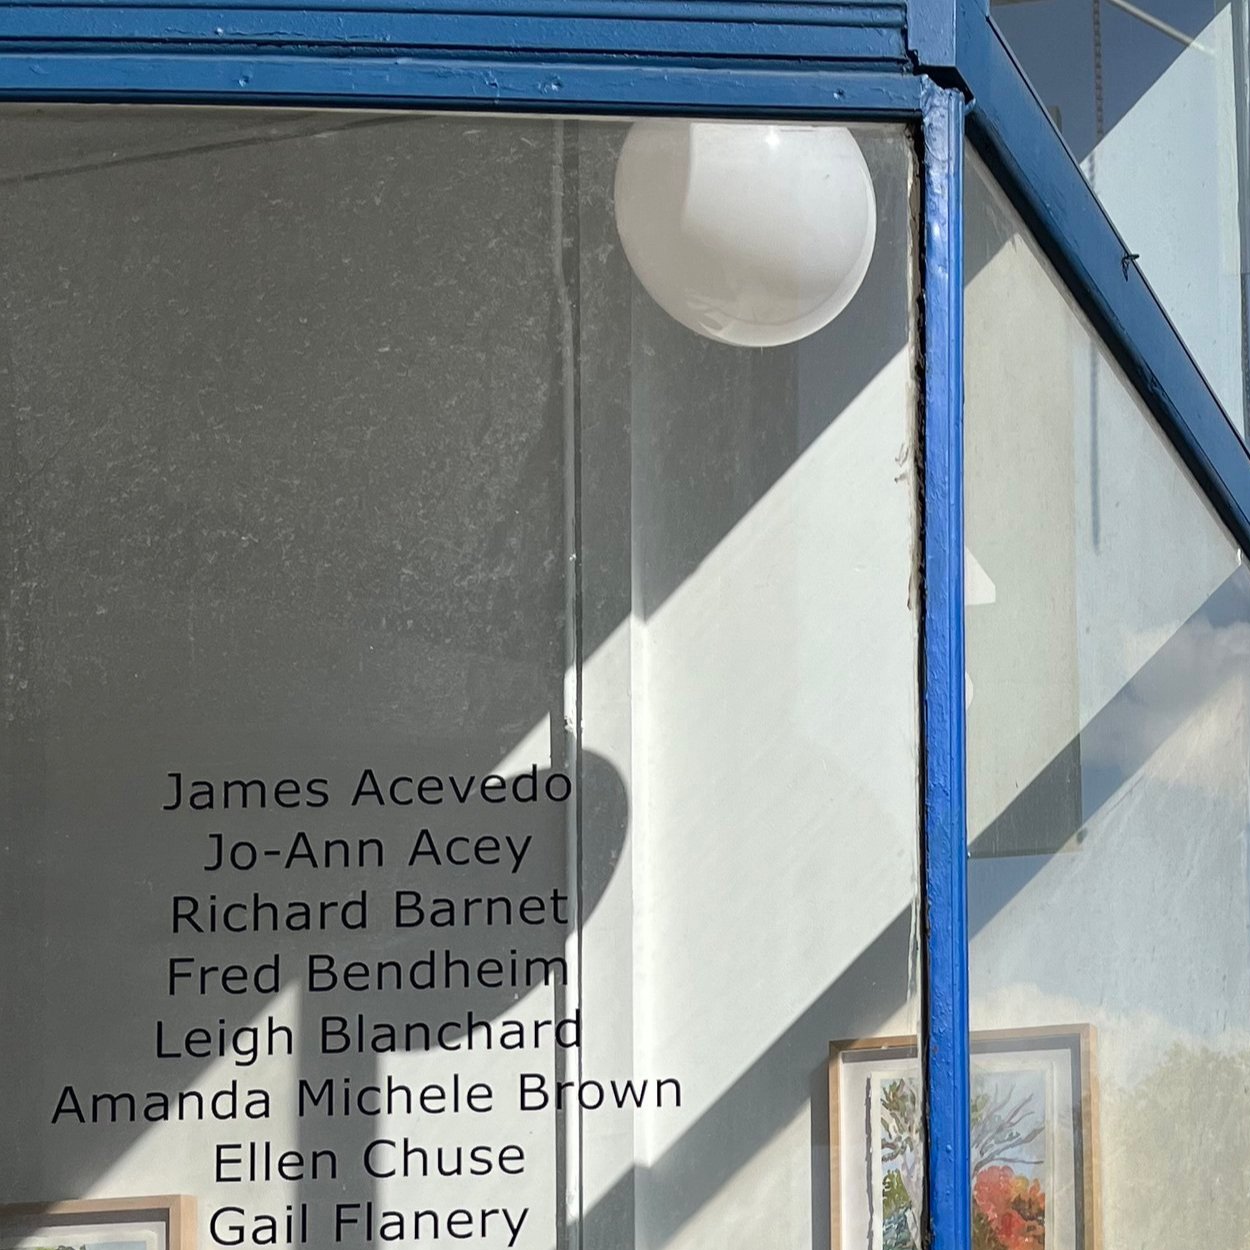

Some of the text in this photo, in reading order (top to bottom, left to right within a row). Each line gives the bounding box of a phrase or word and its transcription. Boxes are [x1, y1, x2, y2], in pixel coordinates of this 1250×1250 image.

[163, 764, 572, 811] James Acevedo
[204, 829, 532, 874] Jo-Ann Acey
[172, 888, 569, 934] Richard Barnet
[169, 949, 567, 996] Fred Bendheim
[156, 1008, 581, 1066] Leigh Blanchard
[51, 1074, 681, 1124] Amanda Michele Brown
[216, 1138, 524, 1182] Ellen Chuse
[210, 1201, 528, 1247] Gail Flanery
